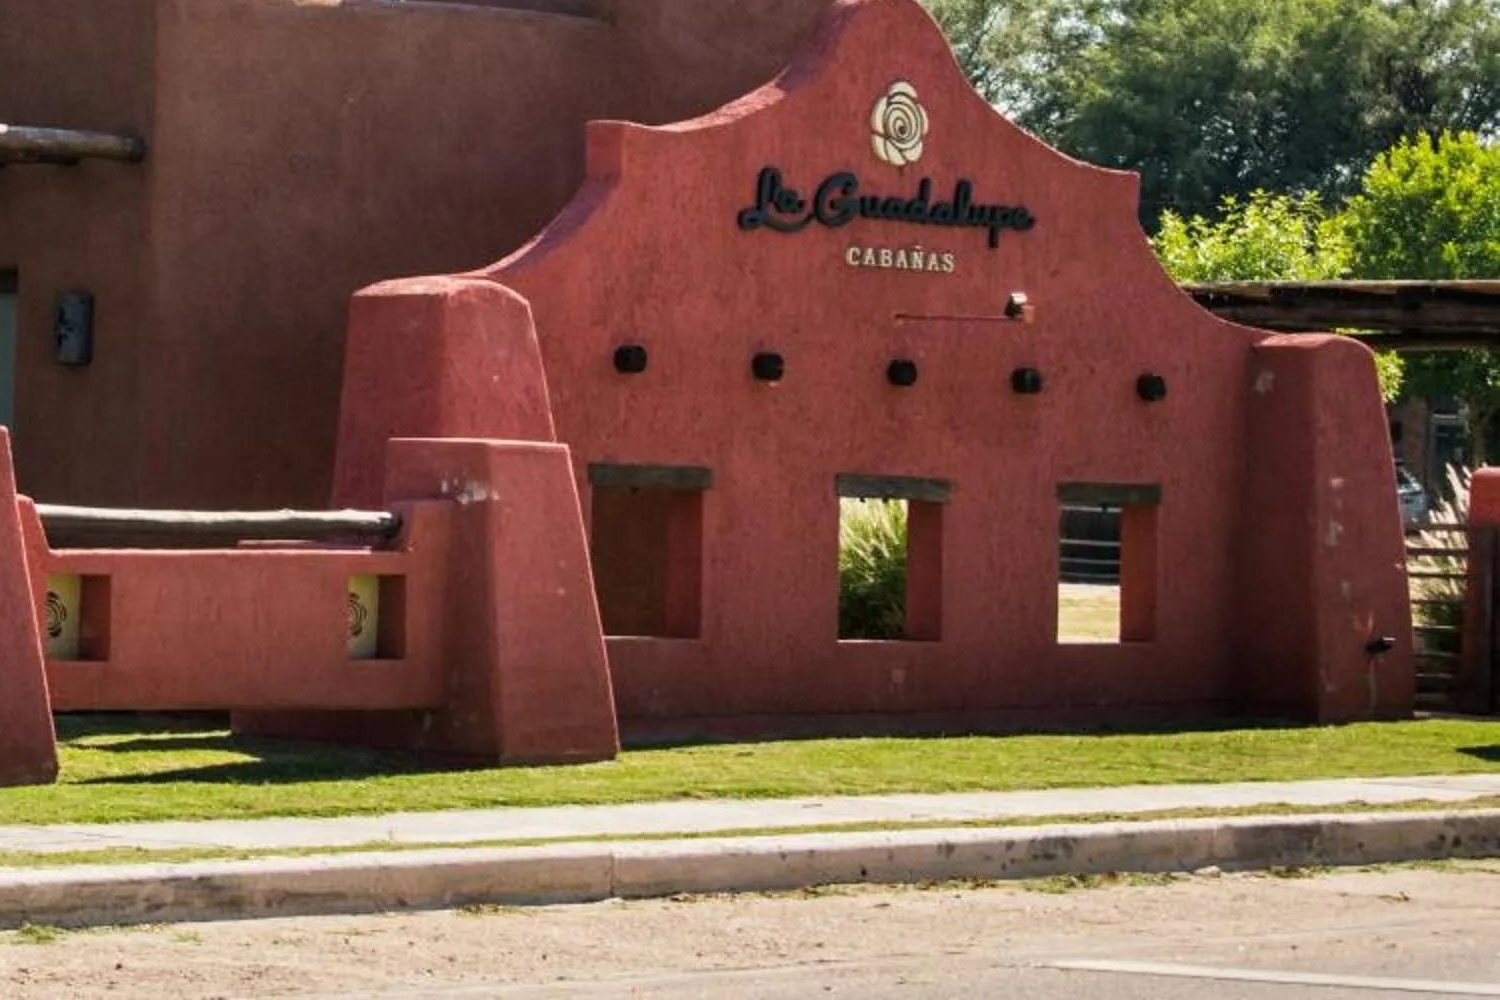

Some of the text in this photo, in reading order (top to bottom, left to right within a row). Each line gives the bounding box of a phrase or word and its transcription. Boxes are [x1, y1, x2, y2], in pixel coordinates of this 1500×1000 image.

[737, 166, 1035, 248] La Guadalupe
[845, 244, 956, 273] CABAÑAS
